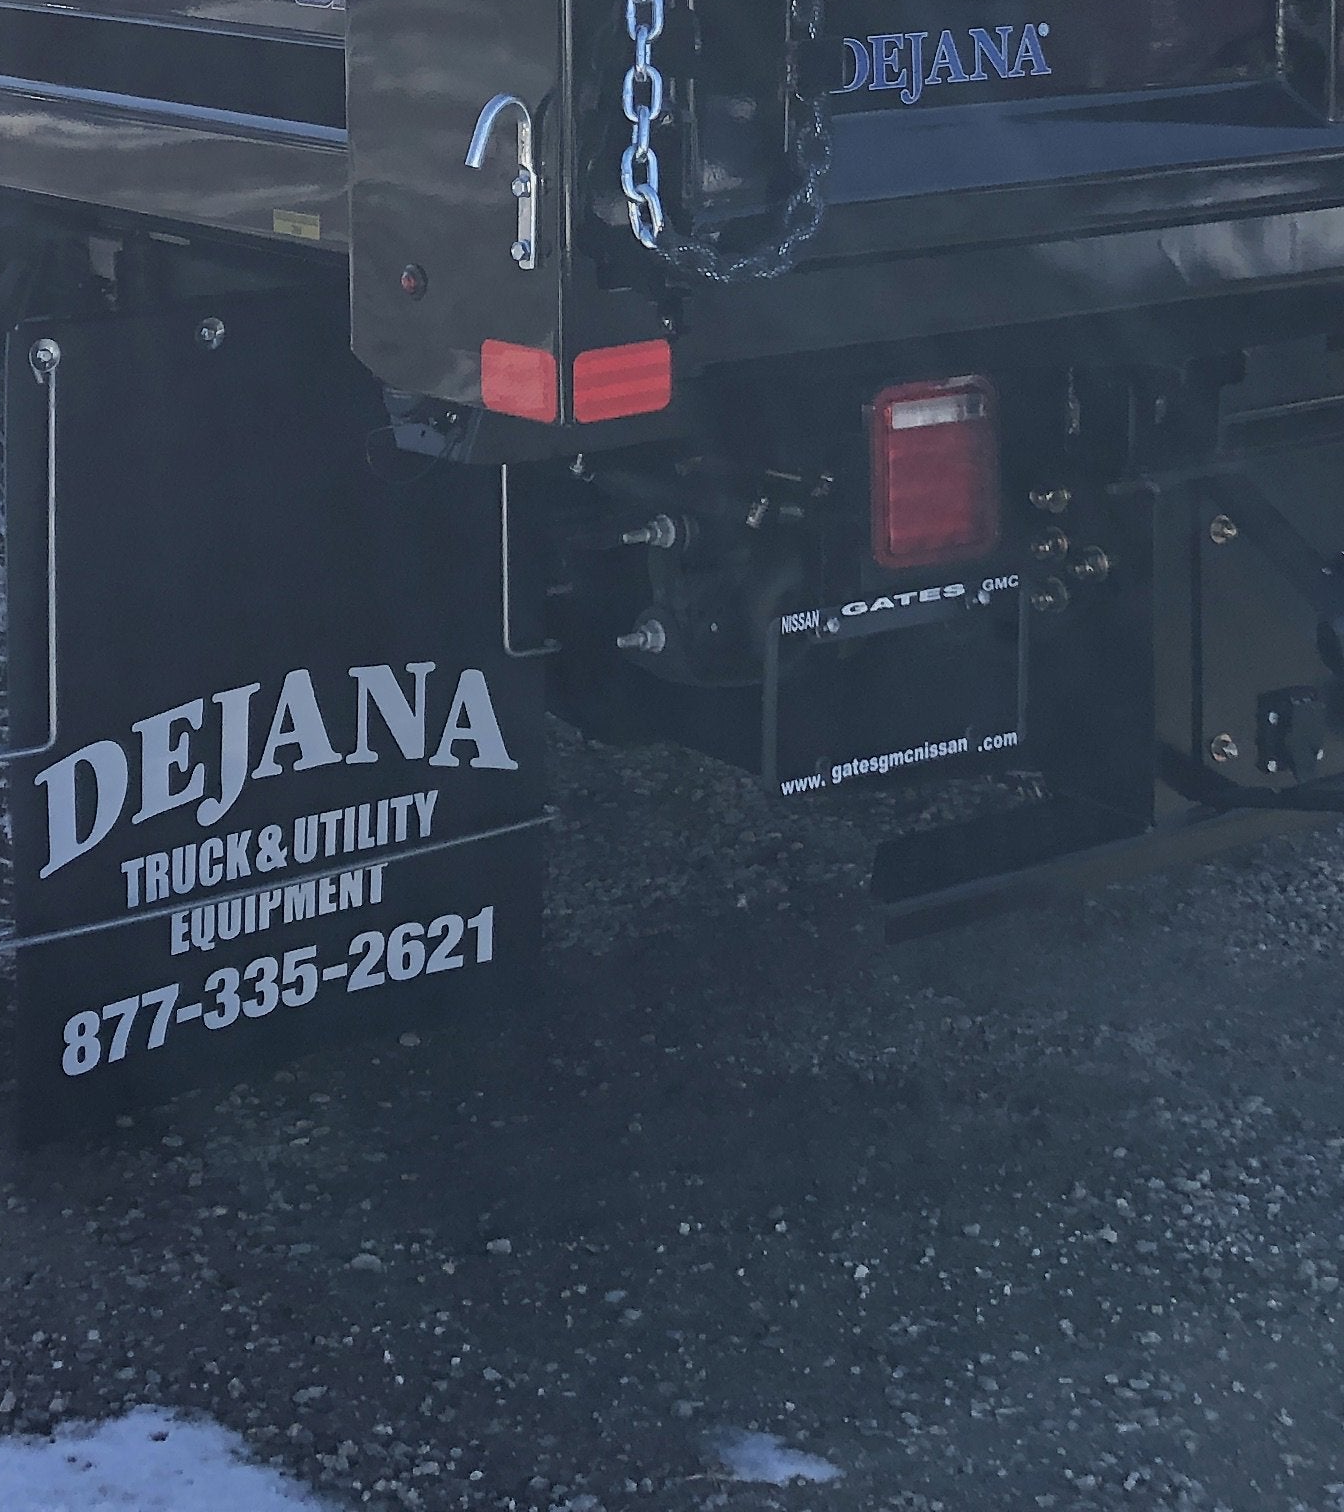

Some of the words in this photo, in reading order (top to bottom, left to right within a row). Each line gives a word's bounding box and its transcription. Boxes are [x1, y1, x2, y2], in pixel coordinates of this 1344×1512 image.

[781, 609, 820, 635] NISSAN
[841, 583, 966, 617] GATES
[982, 574, 1019, 592] GMC
[34, 661, 519, 879] DEJANA
[170, 862, 388, 956] EQUIPMENT
[62, 906, 495, 1077] 877-335-2621
